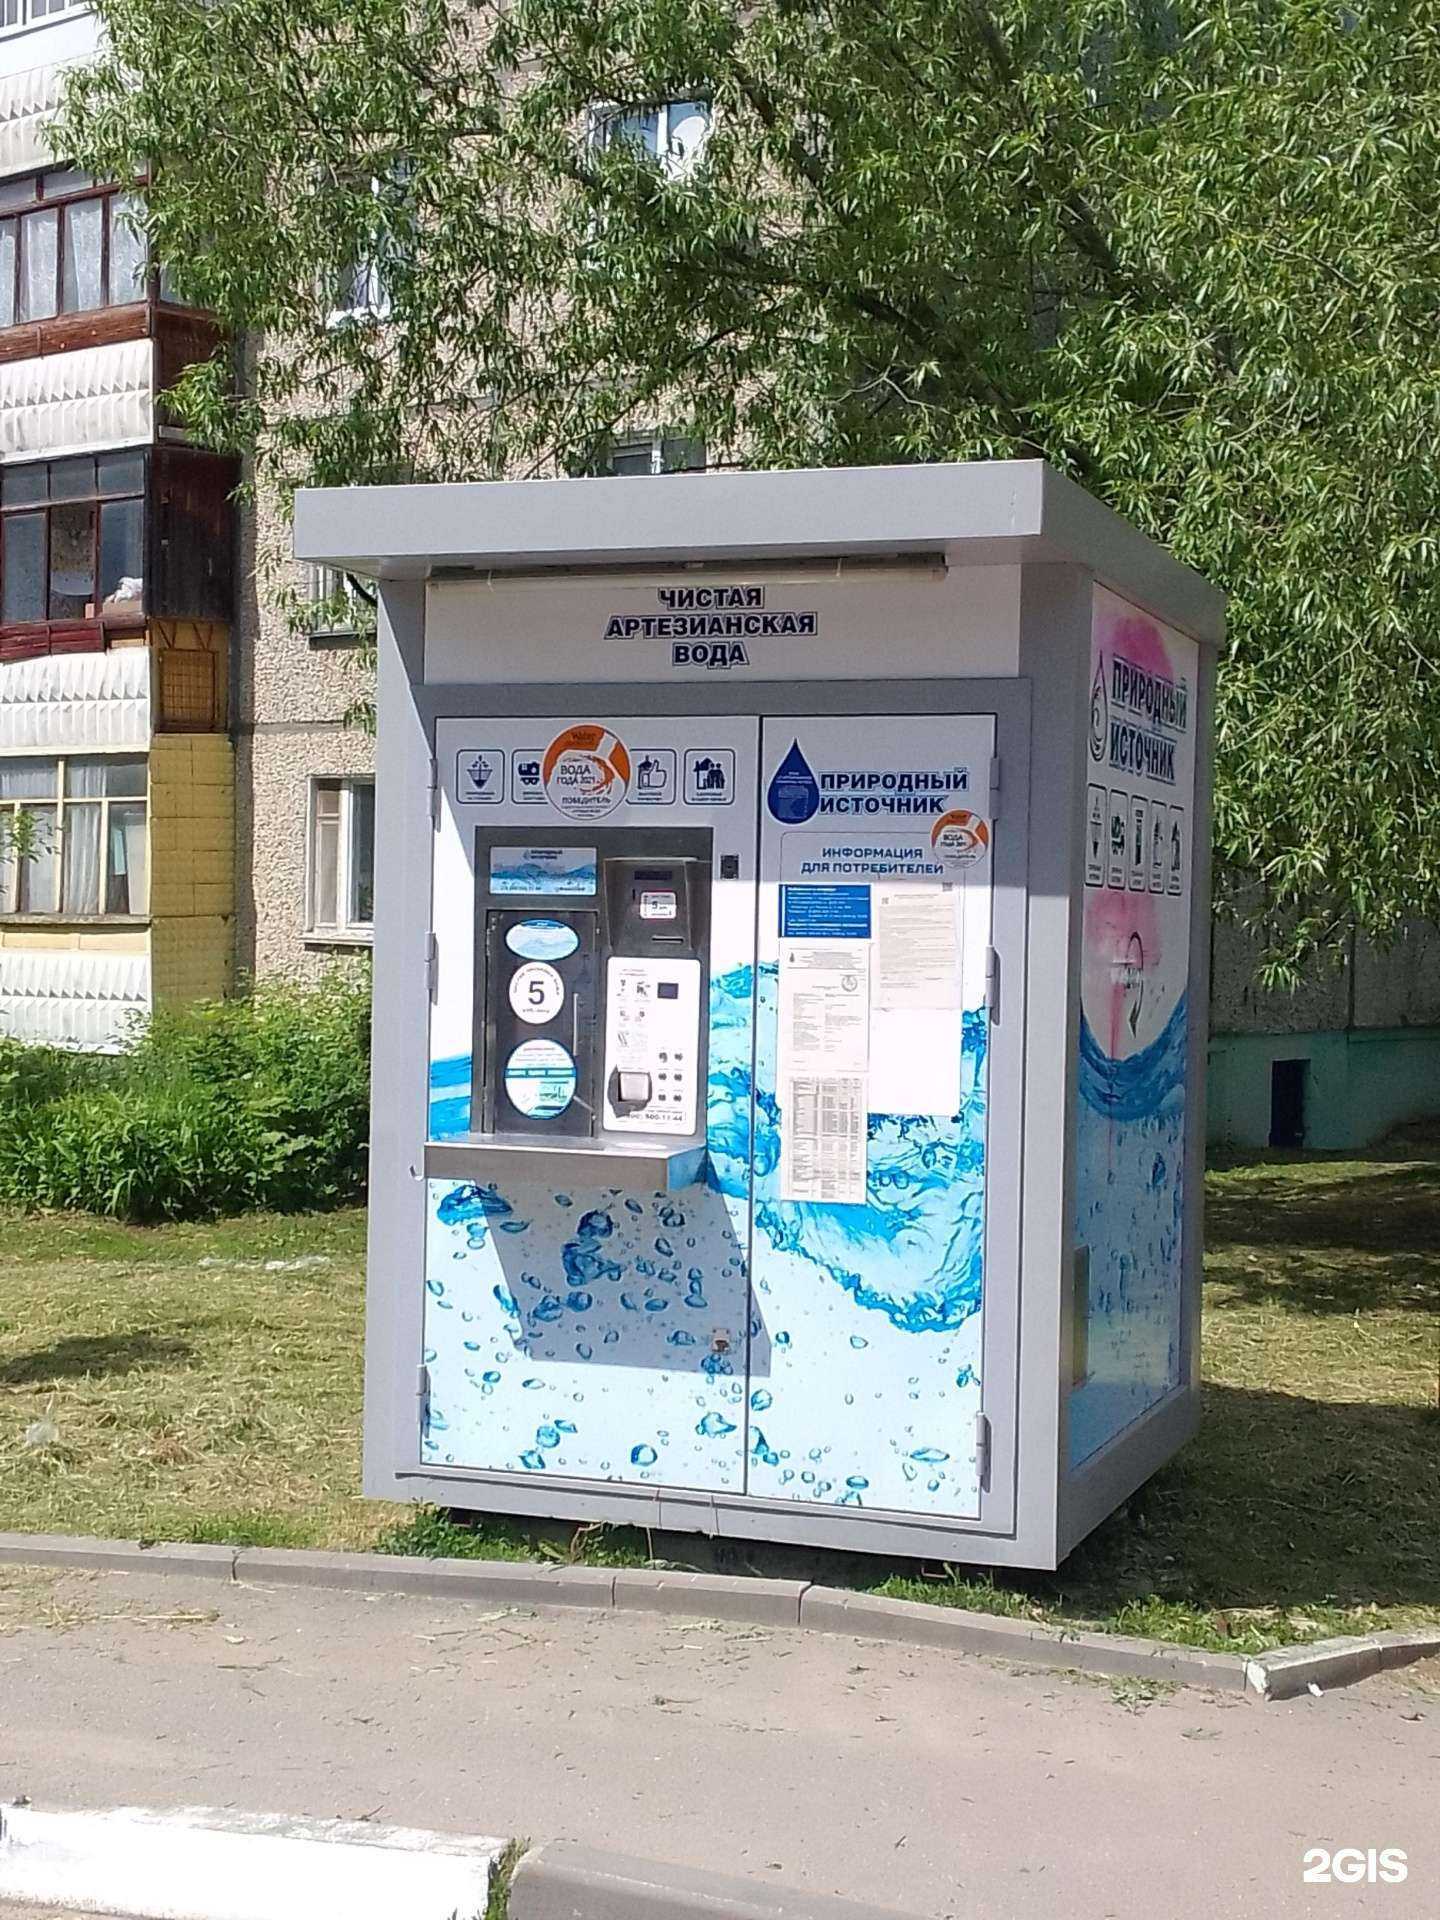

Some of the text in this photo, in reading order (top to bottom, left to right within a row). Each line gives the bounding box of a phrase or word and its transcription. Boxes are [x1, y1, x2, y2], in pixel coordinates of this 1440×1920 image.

[659, 586, 764, 608] ЧИСТАЯ
[605, 613, 816, 637] АРТЕЗИАНСКАЯ
[673, 643, 748, 667] ВОДА
[1111, 658, 1187, 730] ПРИРОДНЫЙ
[1109, 722, 1176, 780] ИСТОЧНИК
[557, 776, 579, 785] ГОДА
[560, 765, 591, 776] ВОДА
[820, 768, 968, 791] ПРИРОДНЫЙ
[561, 796, 611, 805] ПОБЕДИТЕЛЬ
[820, 796, 945, 814] ИСТОЧНИК
[822, 847, 923, 860] ИНФОРМАЦИЯ
[801, 862, 830, 875] ДЛЯ
[528, 980, 545, 1005] 5
